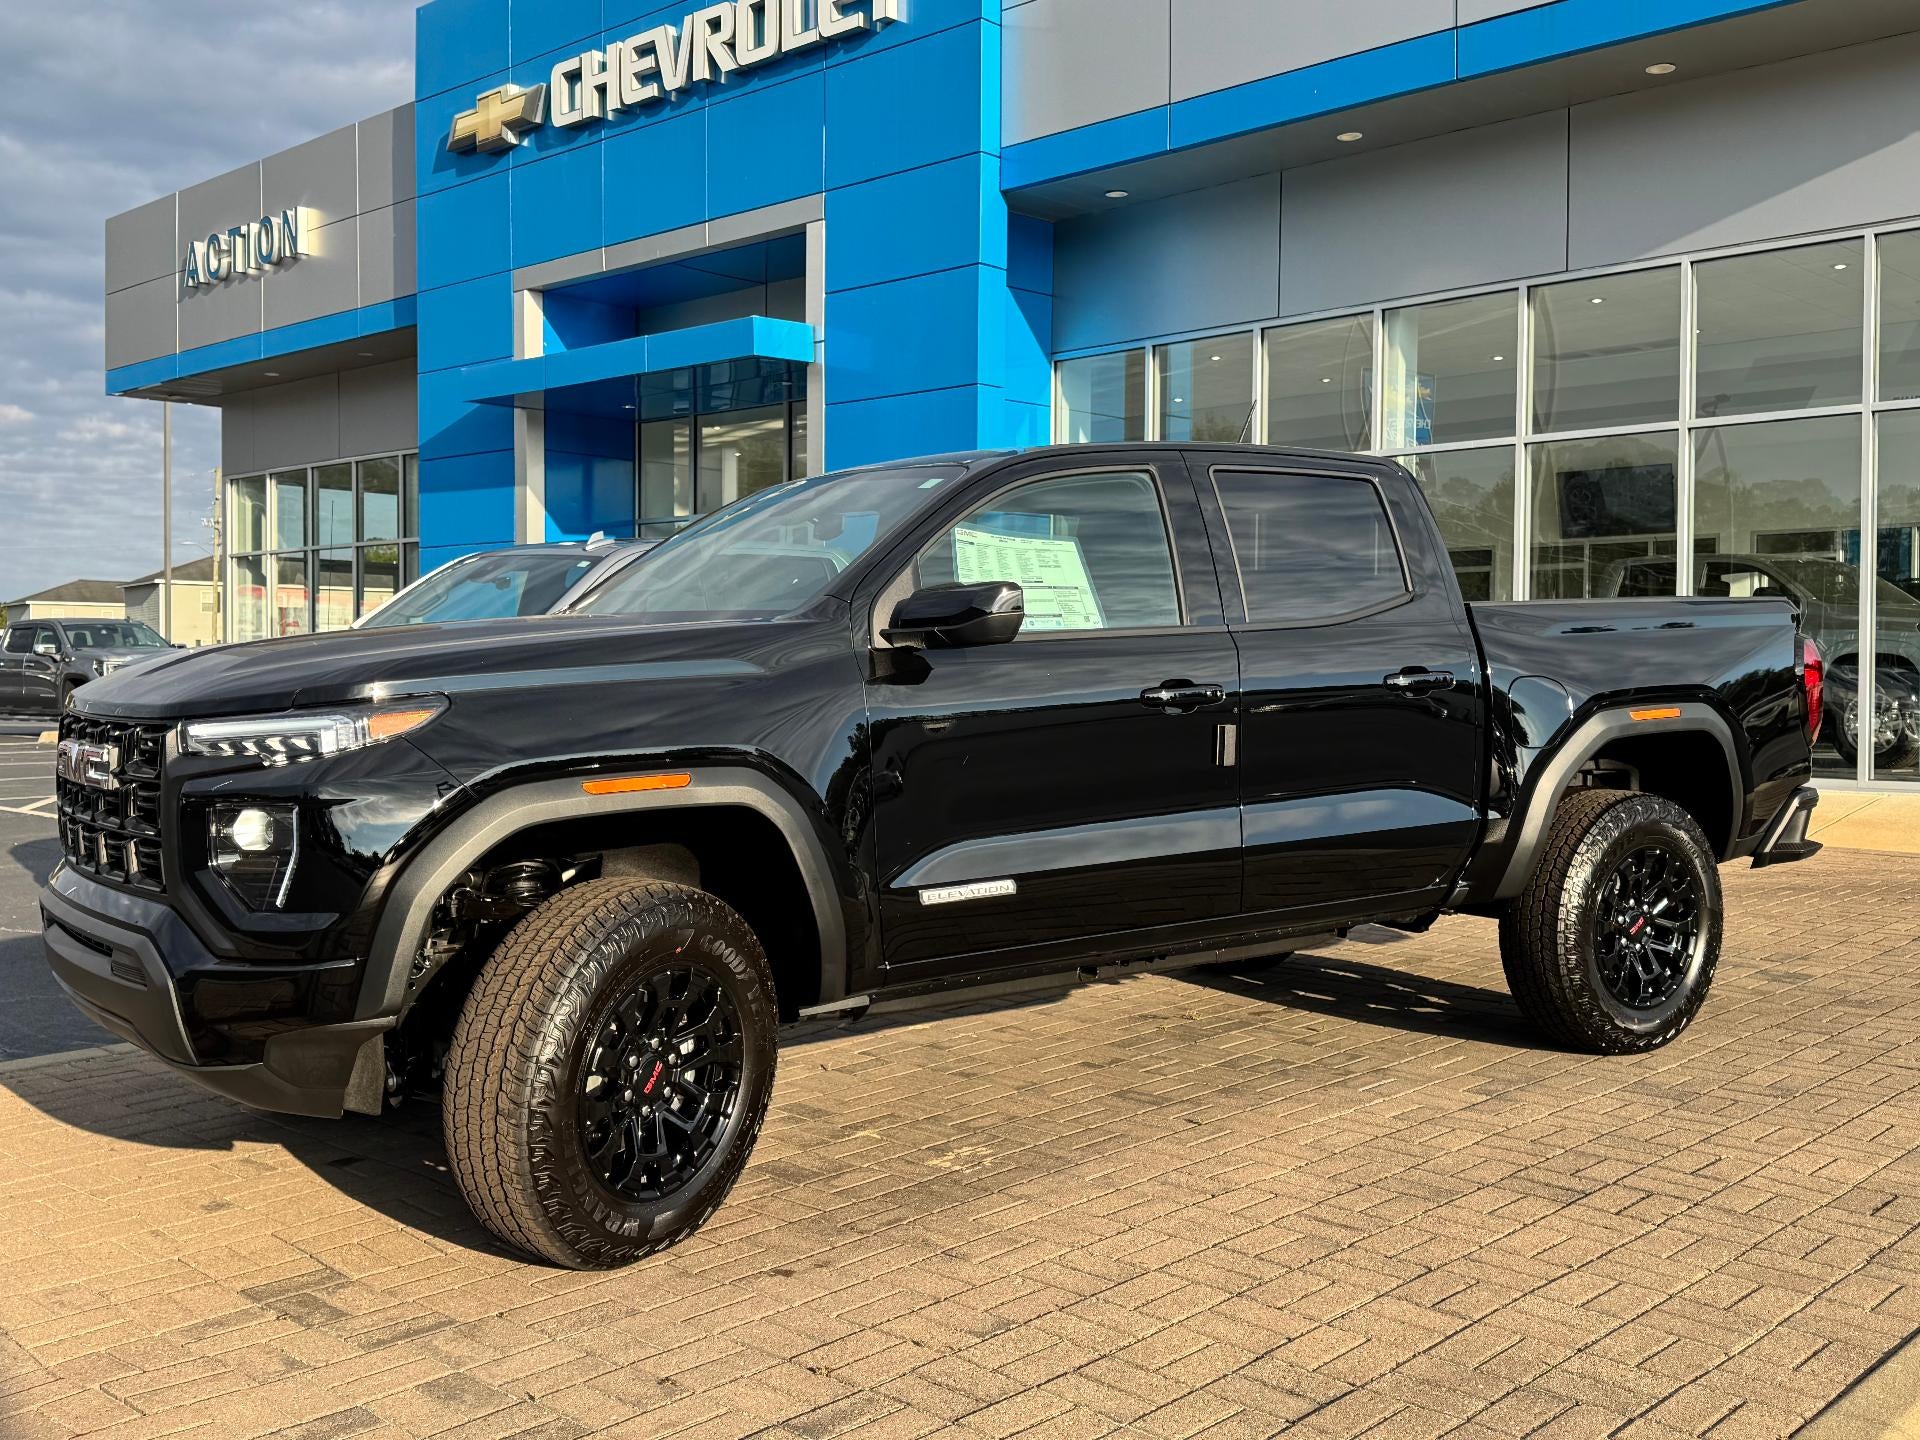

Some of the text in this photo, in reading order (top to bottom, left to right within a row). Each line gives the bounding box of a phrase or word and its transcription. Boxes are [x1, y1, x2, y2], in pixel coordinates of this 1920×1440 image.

[551, 0, 898, 128] CHEVROLE
[184, 206, 308, 288] ACTION
[927, 884, 1010, 901] ELEVATION
[643, 1060, 663, 1094] GMC
